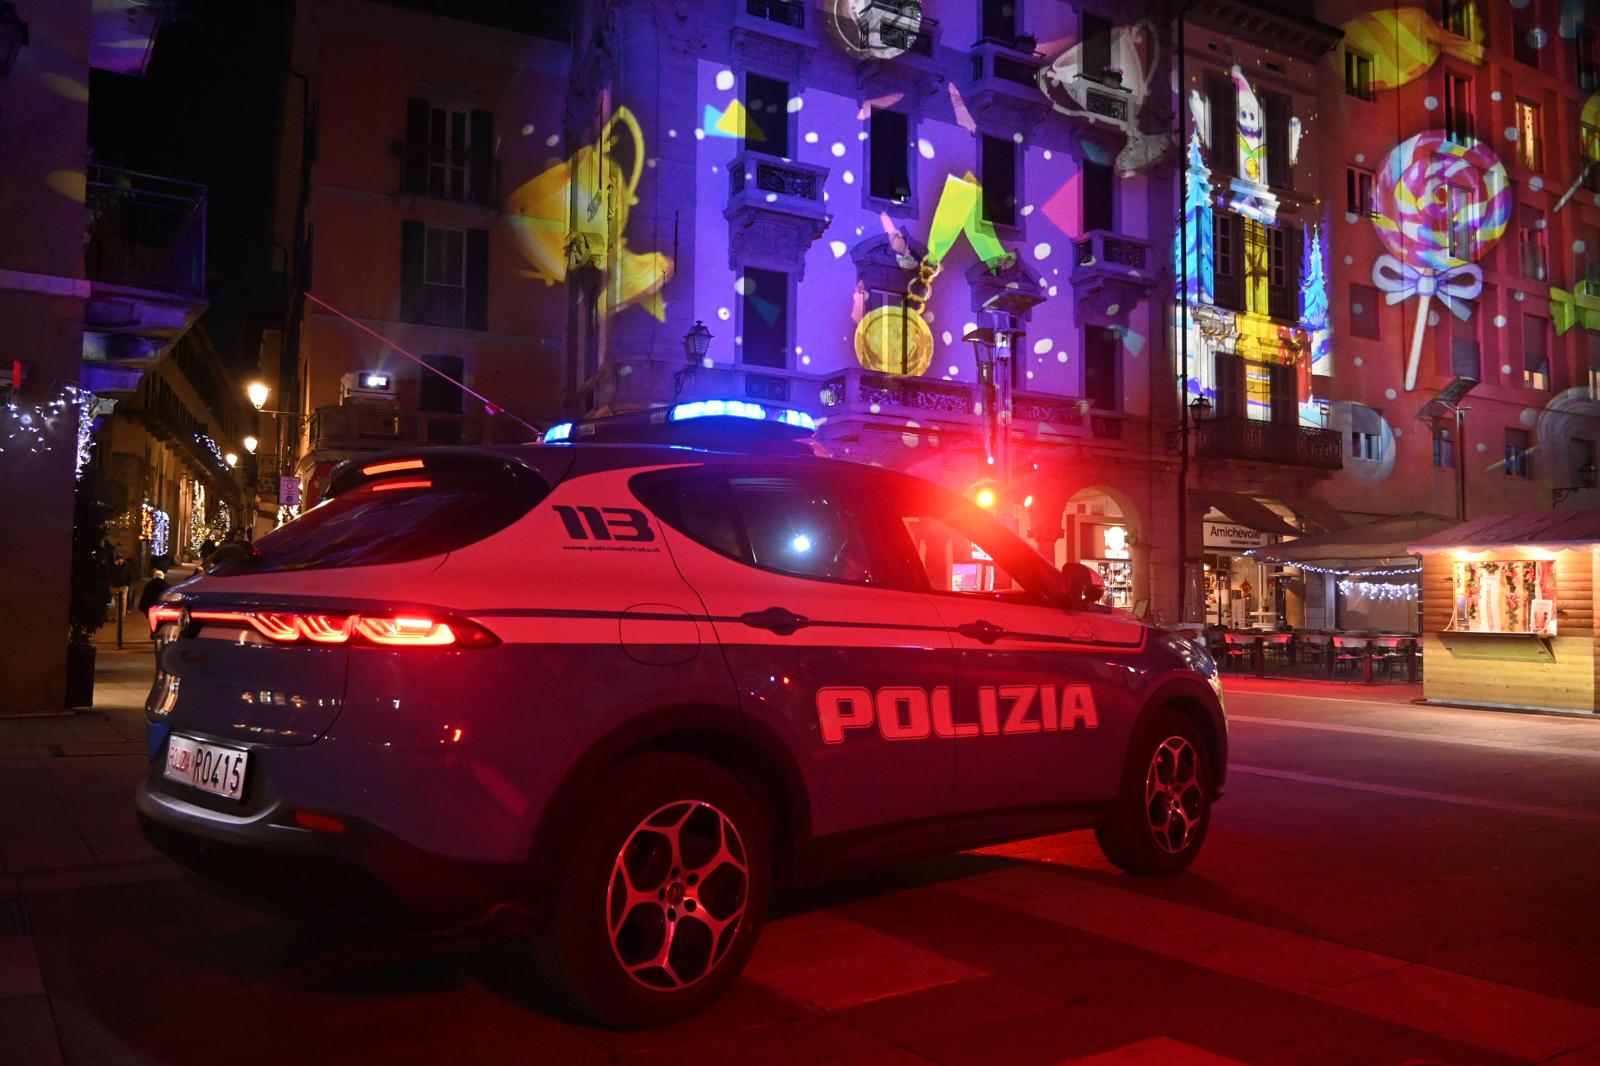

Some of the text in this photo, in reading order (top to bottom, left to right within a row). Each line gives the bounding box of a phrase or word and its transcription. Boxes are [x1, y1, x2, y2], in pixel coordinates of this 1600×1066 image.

[551, 505, 655, 542] 113
[1210, 525, 1261, 539] Amichevole
[816, 685, 1098, 744] POLIZIA
